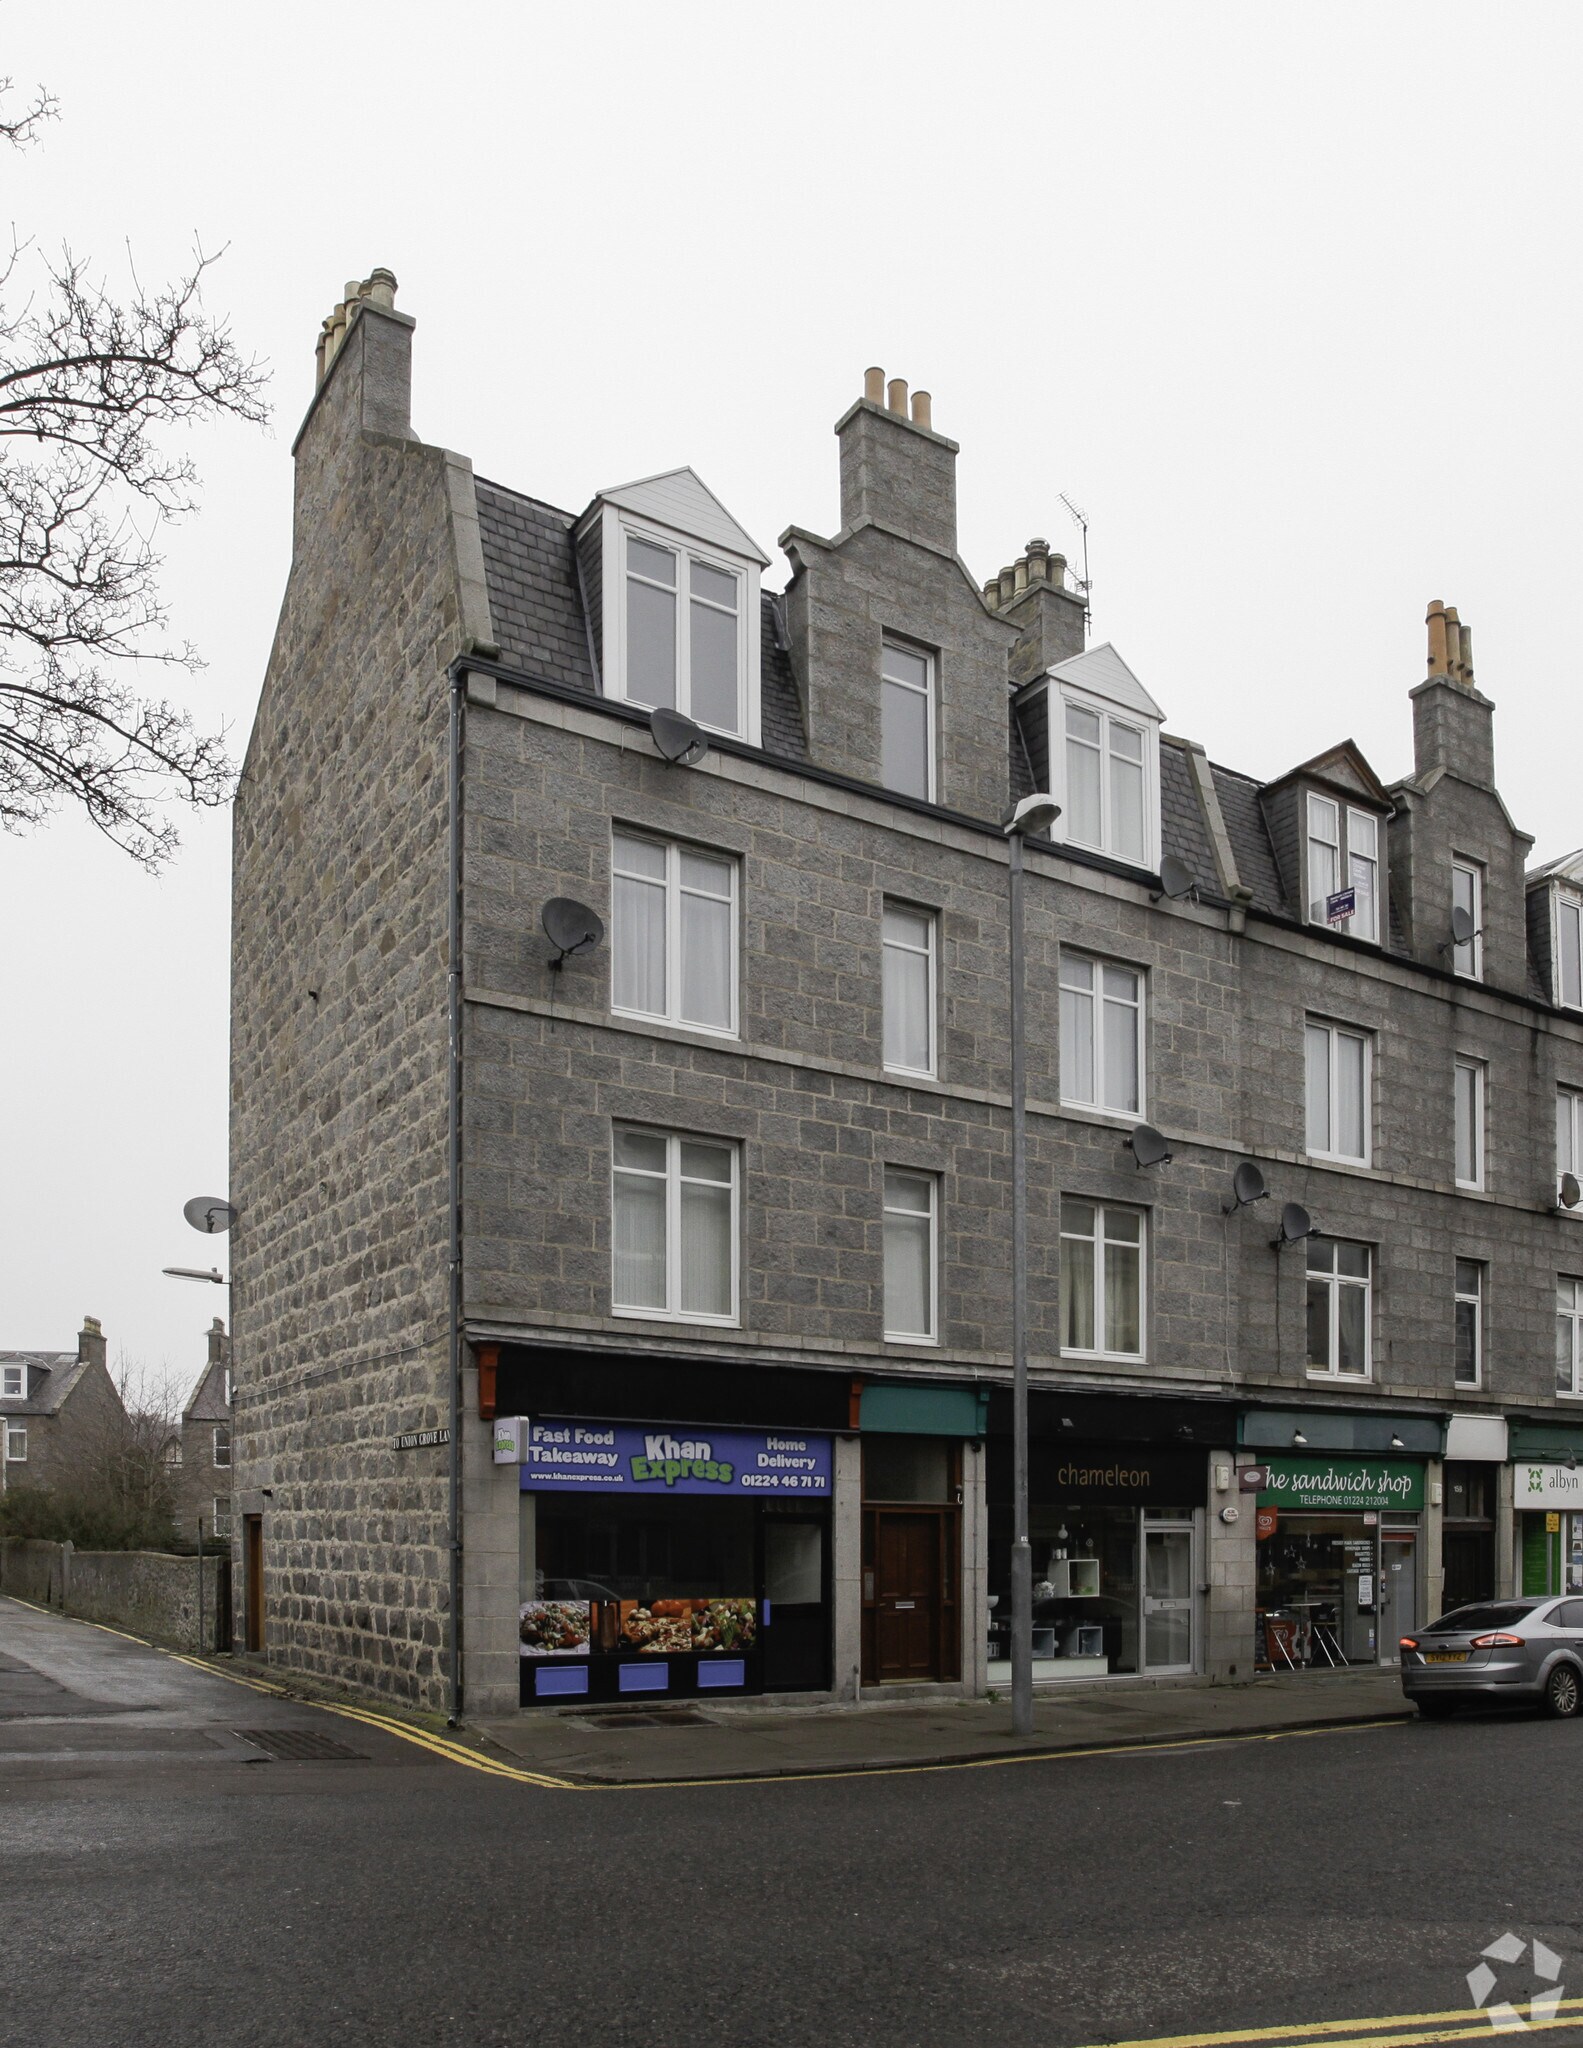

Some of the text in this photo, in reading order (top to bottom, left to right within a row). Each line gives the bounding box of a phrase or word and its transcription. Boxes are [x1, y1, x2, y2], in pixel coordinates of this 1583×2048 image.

[1330, 910, 1354, 922] FOR SALE
[393, 1429, 450, 1449] TO UNION GROVE LA
[533, 1427, 614, 1445] Fast Food
[767, 1438, 806, 1451] Home
[529, 1447, 619, 1466] Takeaway
[645, 1435, 711, 1461] Khan
[631, 1456, 734, 1486] Express
[757, 1454, 816, 1471] Delivery
[741, 1475, 825, 1488] 01224 46 71 71
[1058, 1463, 1150, 1486] chameleon
[1265, 1465, 1290, 1490] he
[1292, 1467, 1376, 1491] sandwich
[1378, 1472, 1411, 1499] shop
[1549, 1469, 1579, 1495] albyn
[1300, 1494, 1389, 1506] TELEPHONE 01224 212004
